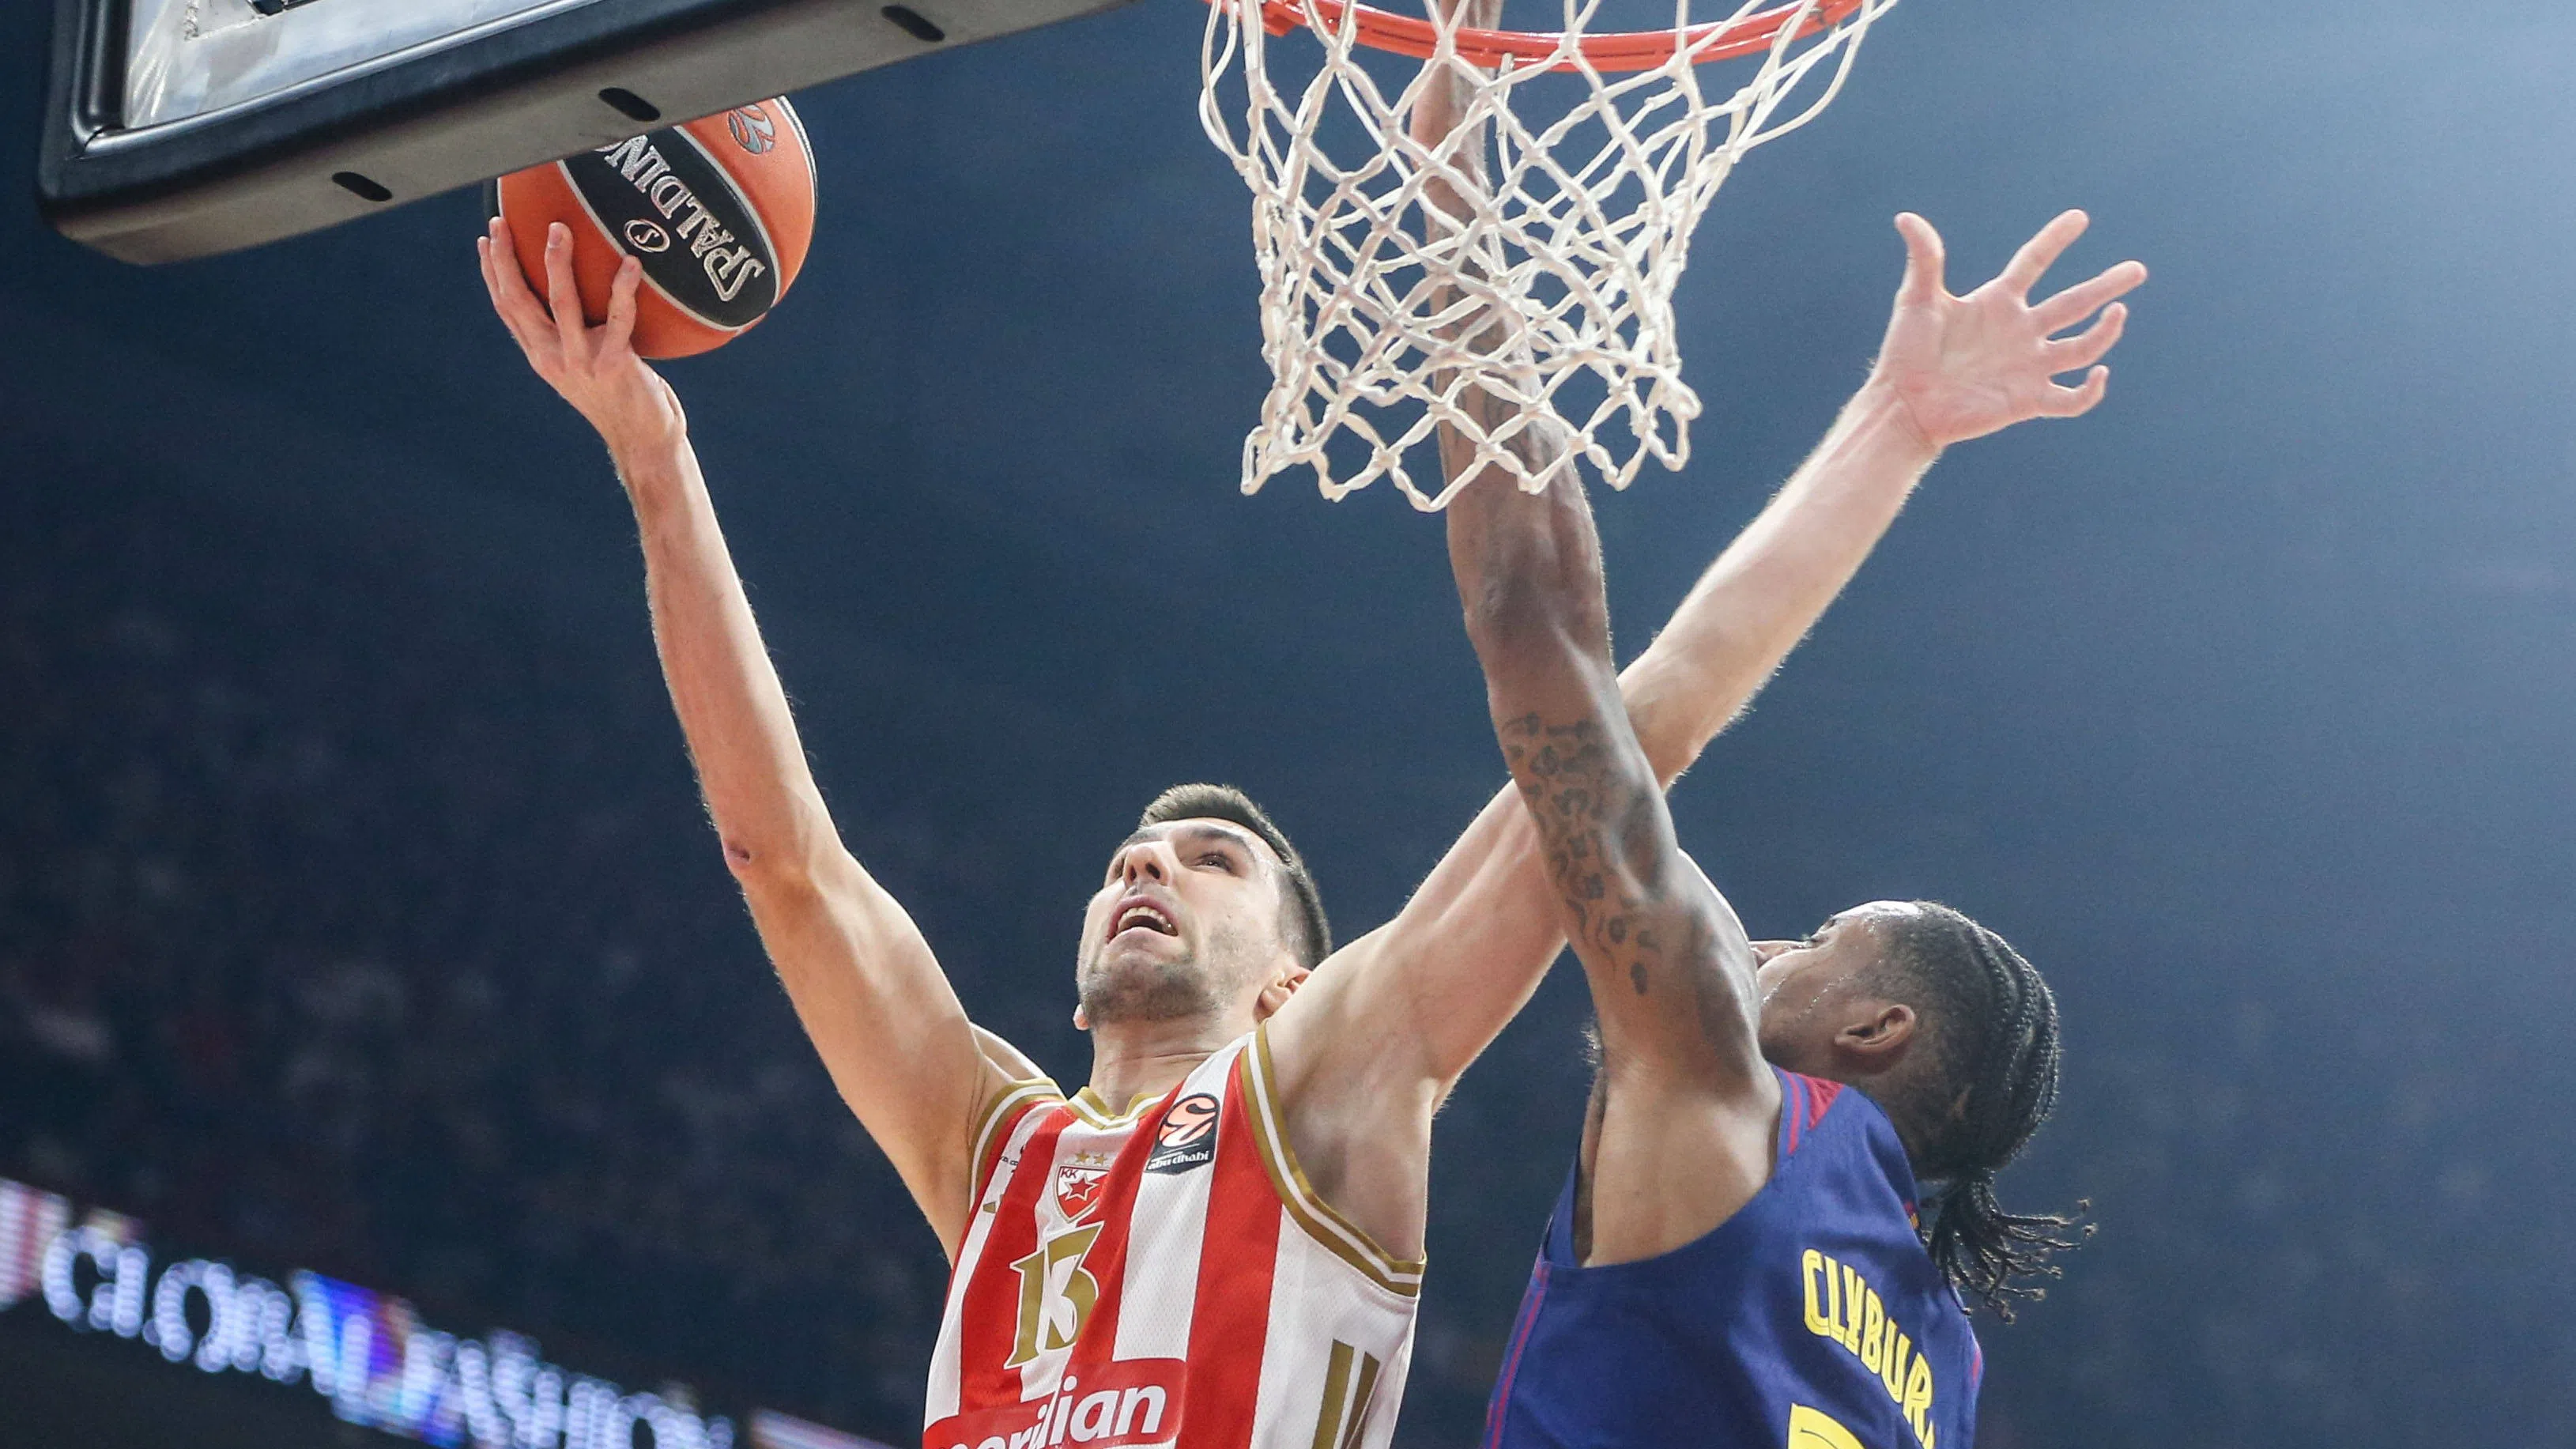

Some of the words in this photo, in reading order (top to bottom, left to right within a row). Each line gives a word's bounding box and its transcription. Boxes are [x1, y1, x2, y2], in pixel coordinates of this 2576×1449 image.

[594, 134, 765, 302] SPALDIN
[1060, 1168, 1078, 1179] KK
[1147, 1157, 1171, 1170] abu
[1172, 1150, 1210, 1165] dhabi
[1004, 1221, 1104, 1368] 13
[1801, 1247, 1935, 1449] CLYBUR
